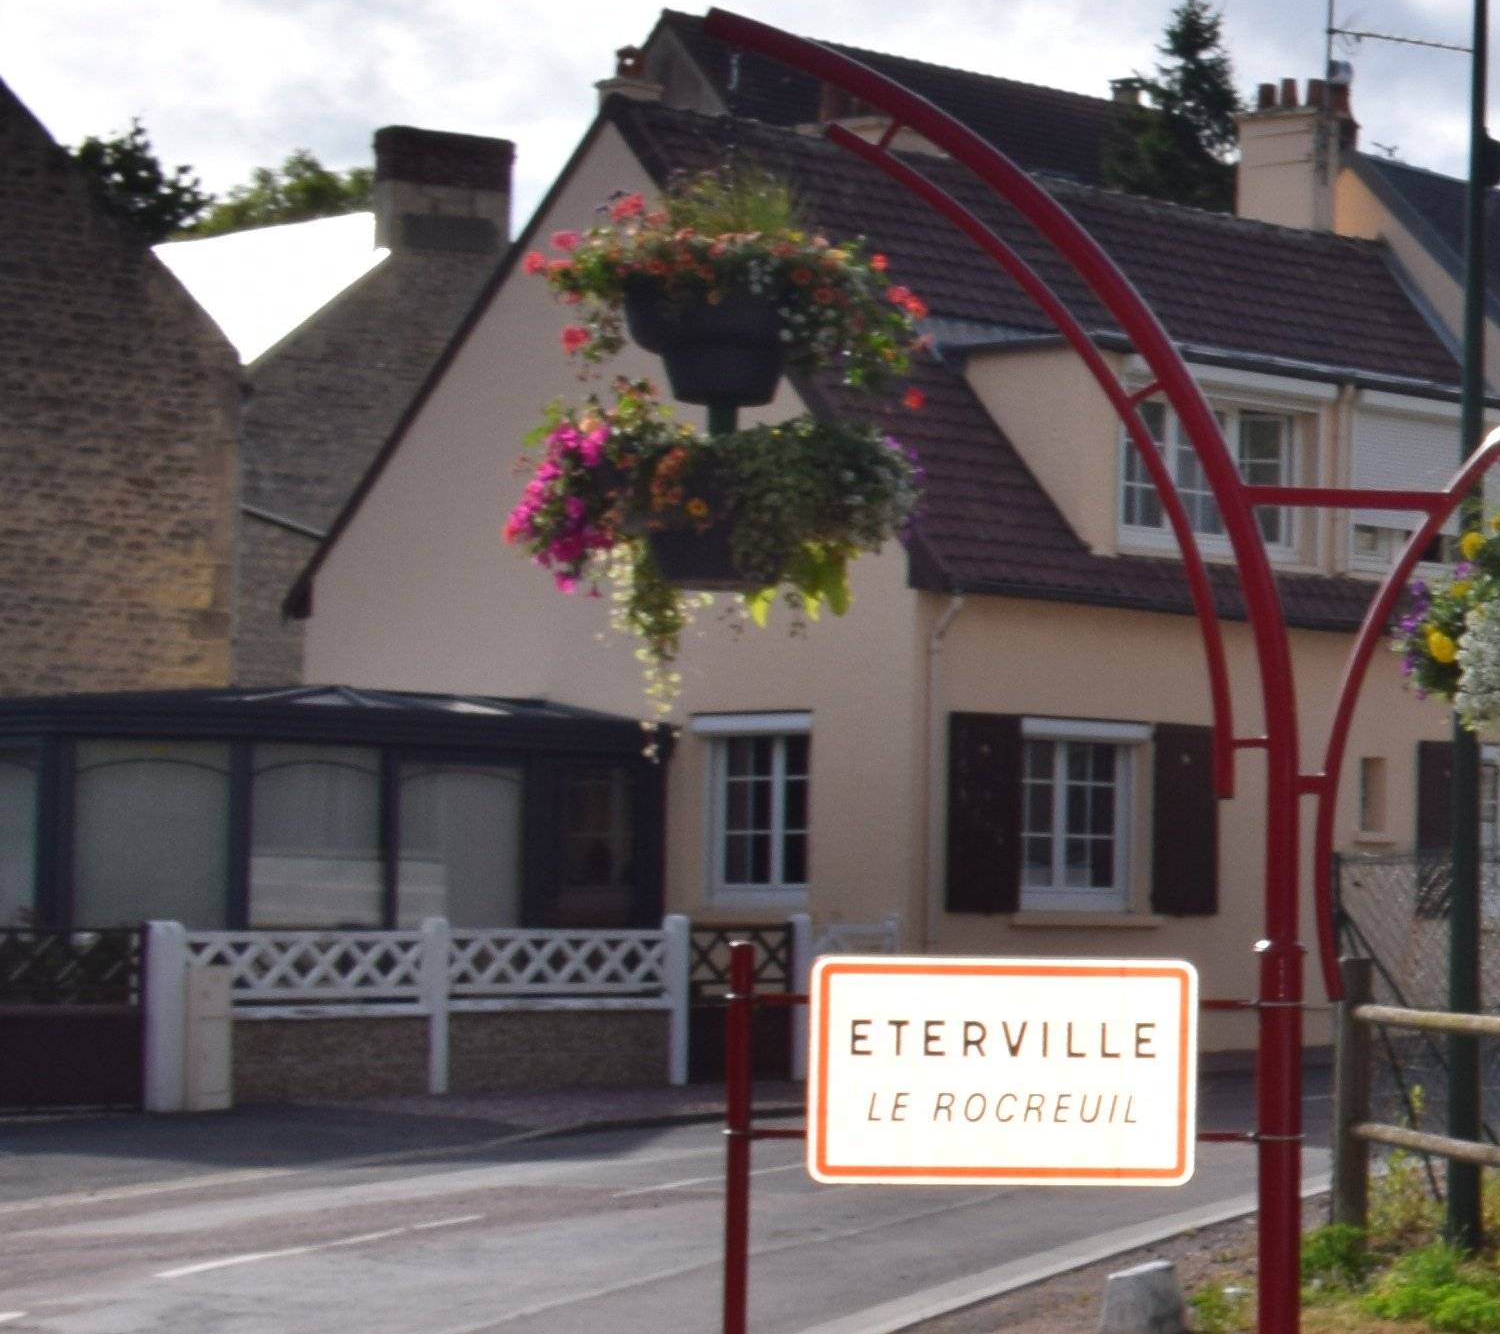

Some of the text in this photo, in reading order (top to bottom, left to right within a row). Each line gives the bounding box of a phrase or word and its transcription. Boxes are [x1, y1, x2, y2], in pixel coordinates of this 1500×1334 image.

[849, 1018, 1158, 1059] ETERVILLE
[866, 1091, 1140, 1125] LE ROCREUIL
